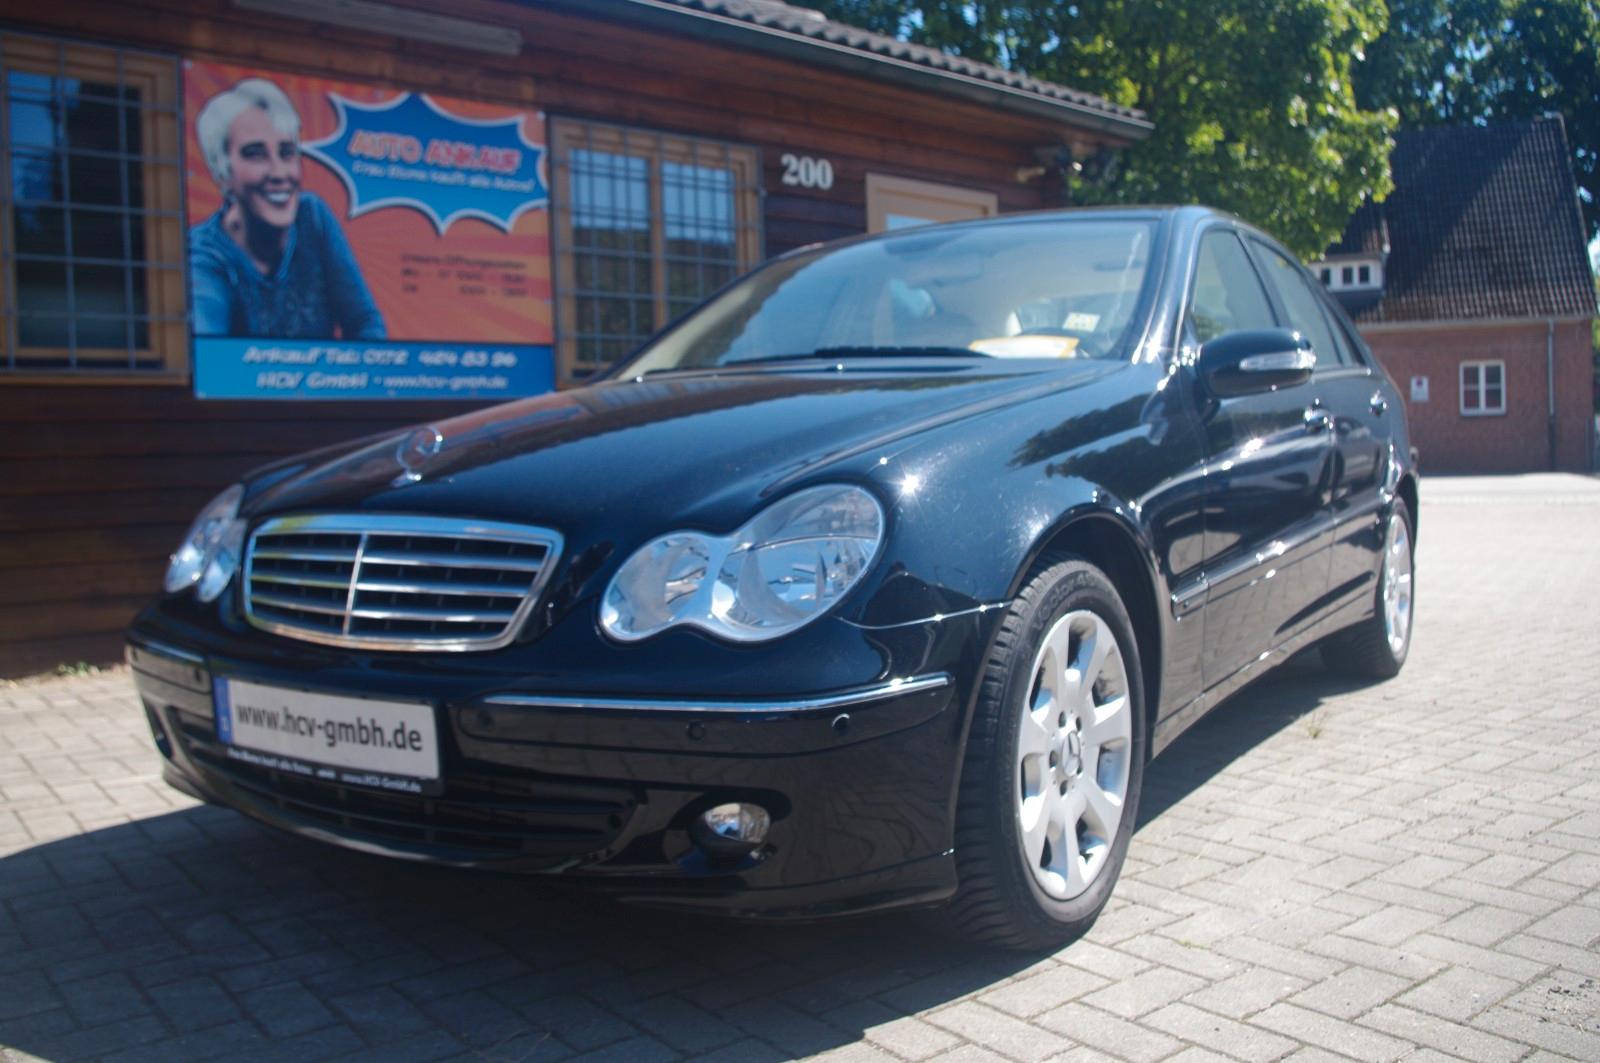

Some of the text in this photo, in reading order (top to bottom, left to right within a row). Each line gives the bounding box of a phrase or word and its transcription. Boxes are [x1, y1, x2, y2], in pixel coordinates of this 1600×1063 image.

[349, 130, 422, 163] AUTO
[780, 153, 834, 191] 200
[256, 371, 304, 389] HCV
[306, 371, 368, 390] GmbH
[236, 704, 423, 751] www.hcv-gmbh.de
